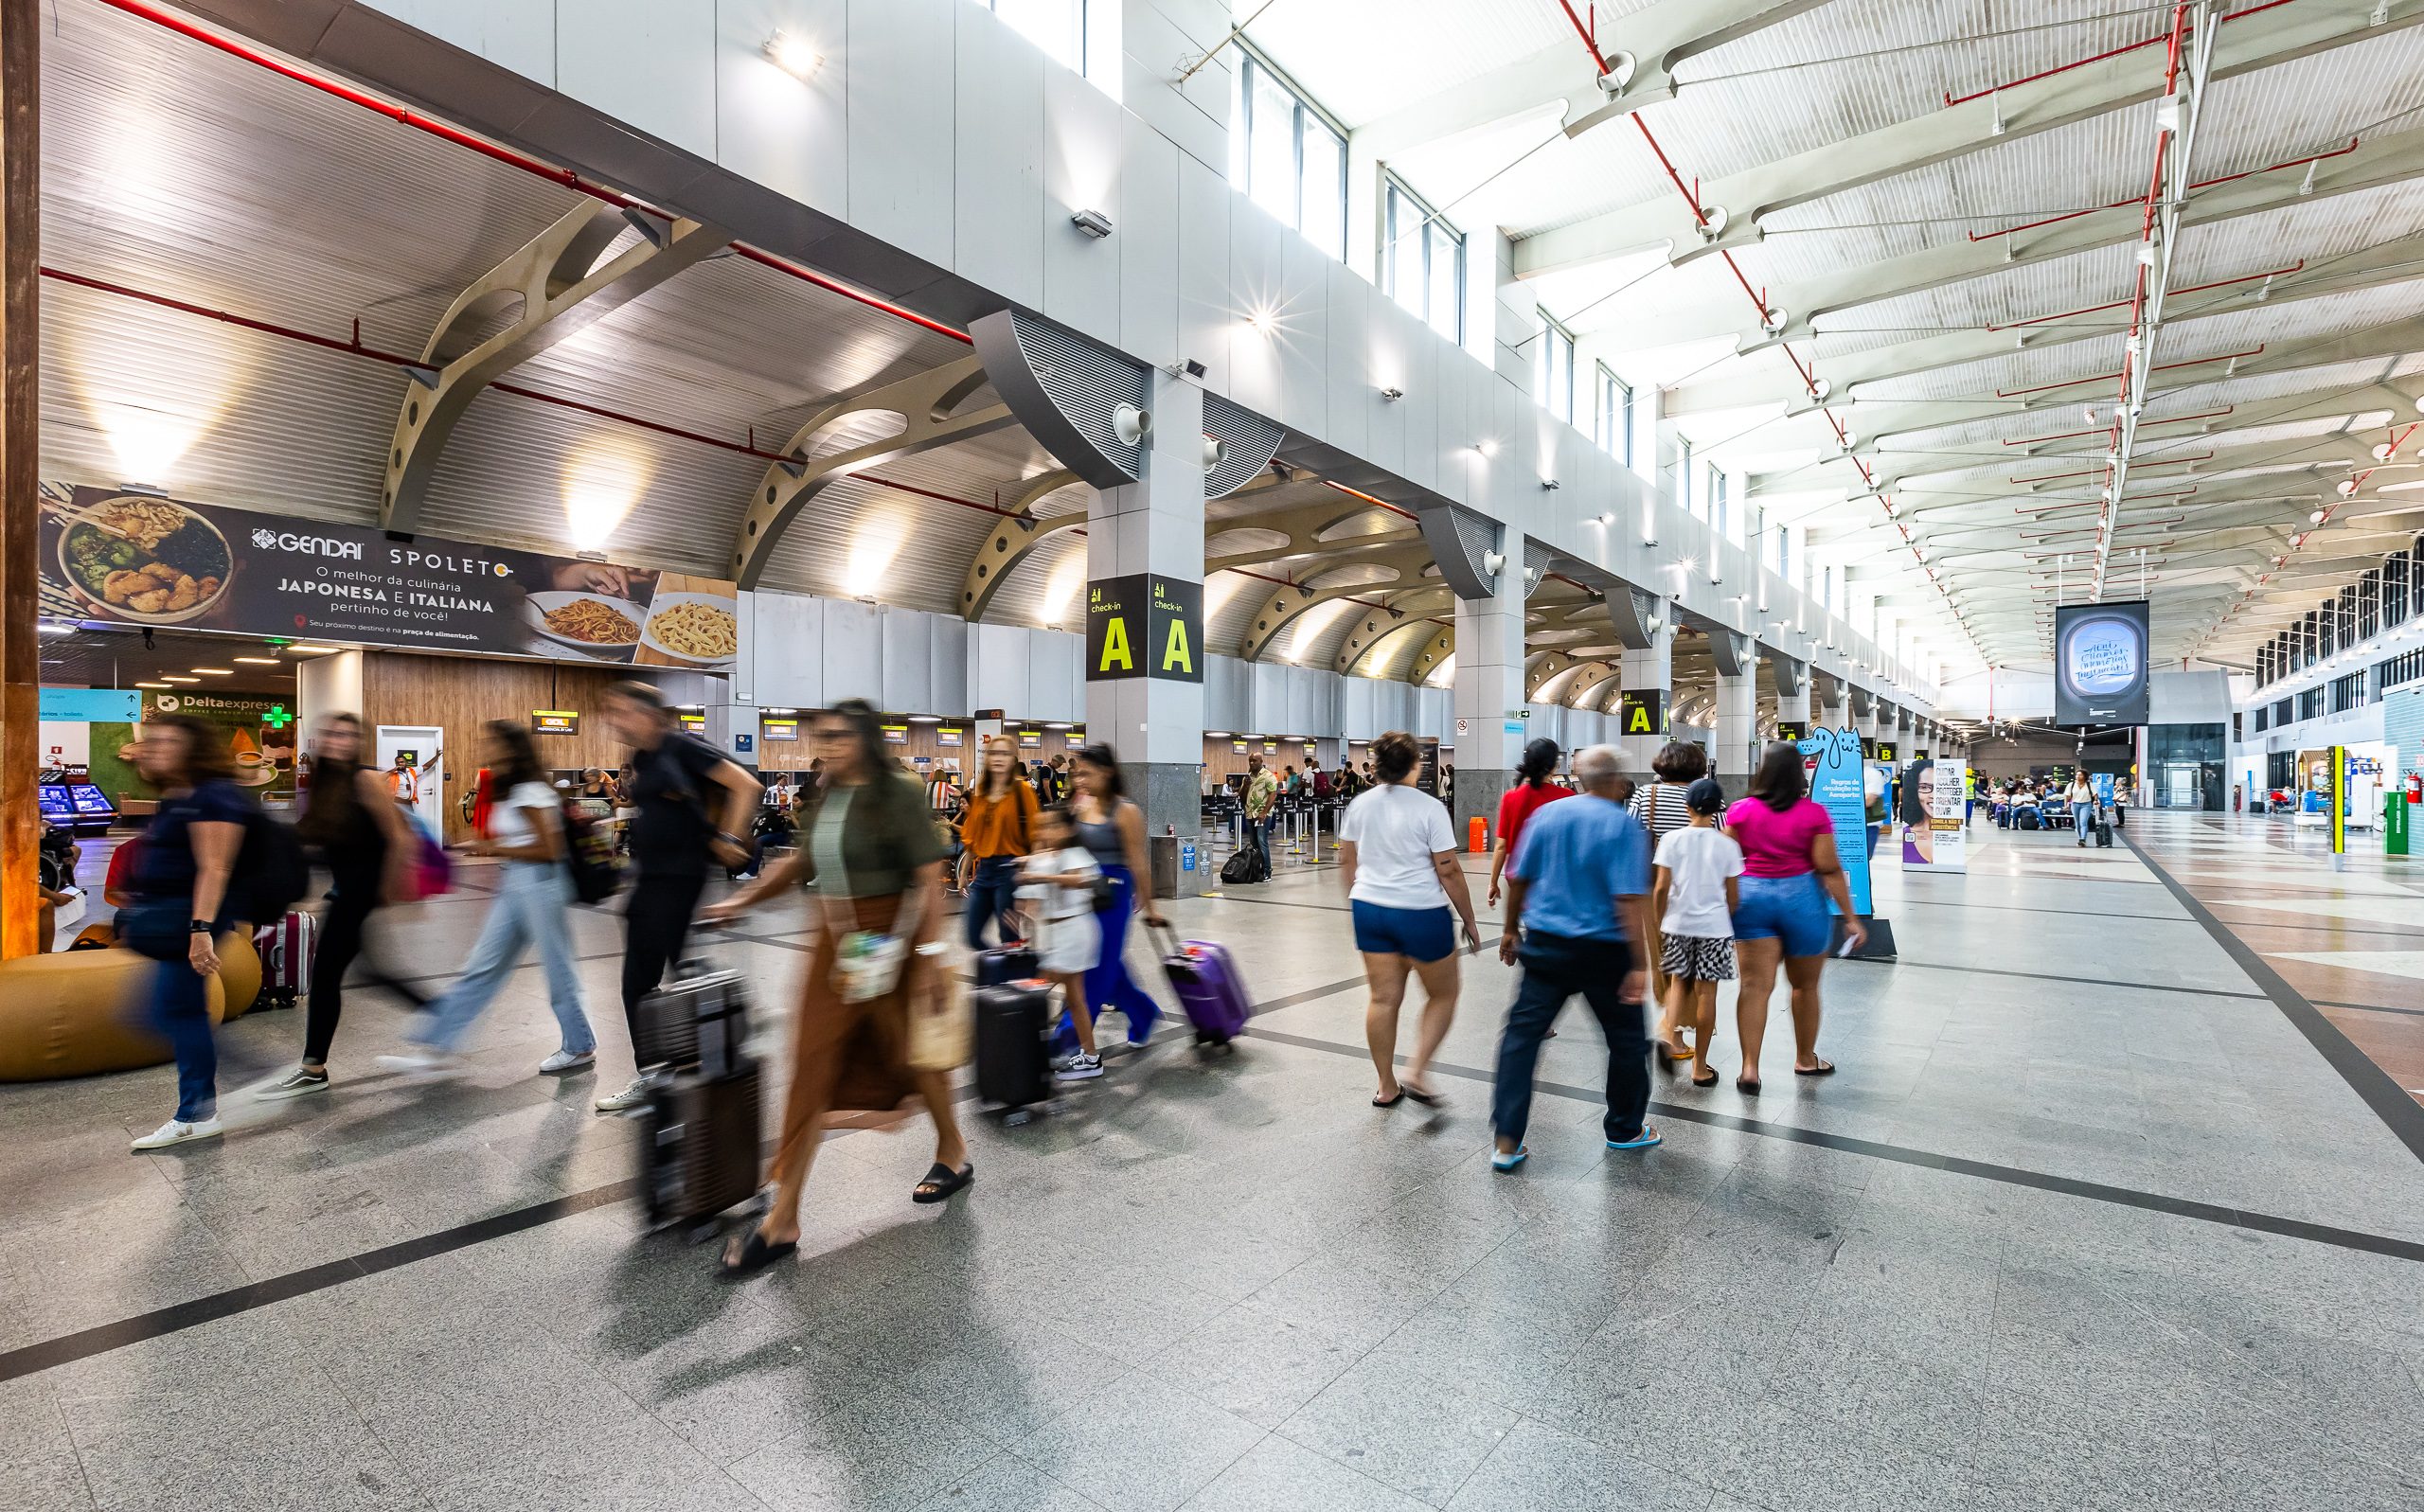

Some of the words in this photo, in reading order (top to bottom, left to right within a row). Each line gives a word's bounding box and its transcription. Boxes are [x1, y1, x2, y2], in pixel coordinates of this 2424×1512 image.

[278, 533, 362, 560] GENDAI
[390, 548, 513, 578] SPOLETO
[316, 566, 329, 577] O
[333, 569, 383, 583] melhor
[387, 575, 402, 586] da
[407, 578, 461, 593] culinária
[277, 578, 386, 602] JAPONESA
[395, 591, 403, 604] E
[410, 593, 494, 614] ITALIANA
[330, 602, 389, 615] pertinho
[393, 607, 410, 617] de
[414, 611, 448, 622] você!
[1091, 601, 1121, 614] check-in
[1154, 599, 1183, 613] check-in
[325, 621, 356, 631] próximo
[358, 624, 384, 632] destino
[435, 631, 480, 640] alimentação.
[1099, 617, 1133, 671] A
[1162, 618, 1192, 673] A
[184, 696, 285, 710] Deltaexpresso
[1630, 707, 1651, 732] A
[1662, 707, 1669, 732] A
[1881, 749, 1892, 760] B
[1936, 767, 1955, 776] CUIDAR
[1936, 777, 1960, 787] ACOLHER
[1936, 787, 1963, 796] PROTEGER
[1935, 797, 1961, 806] ORIENTAR
[1935, 807, 1952, 815] OUVIR
